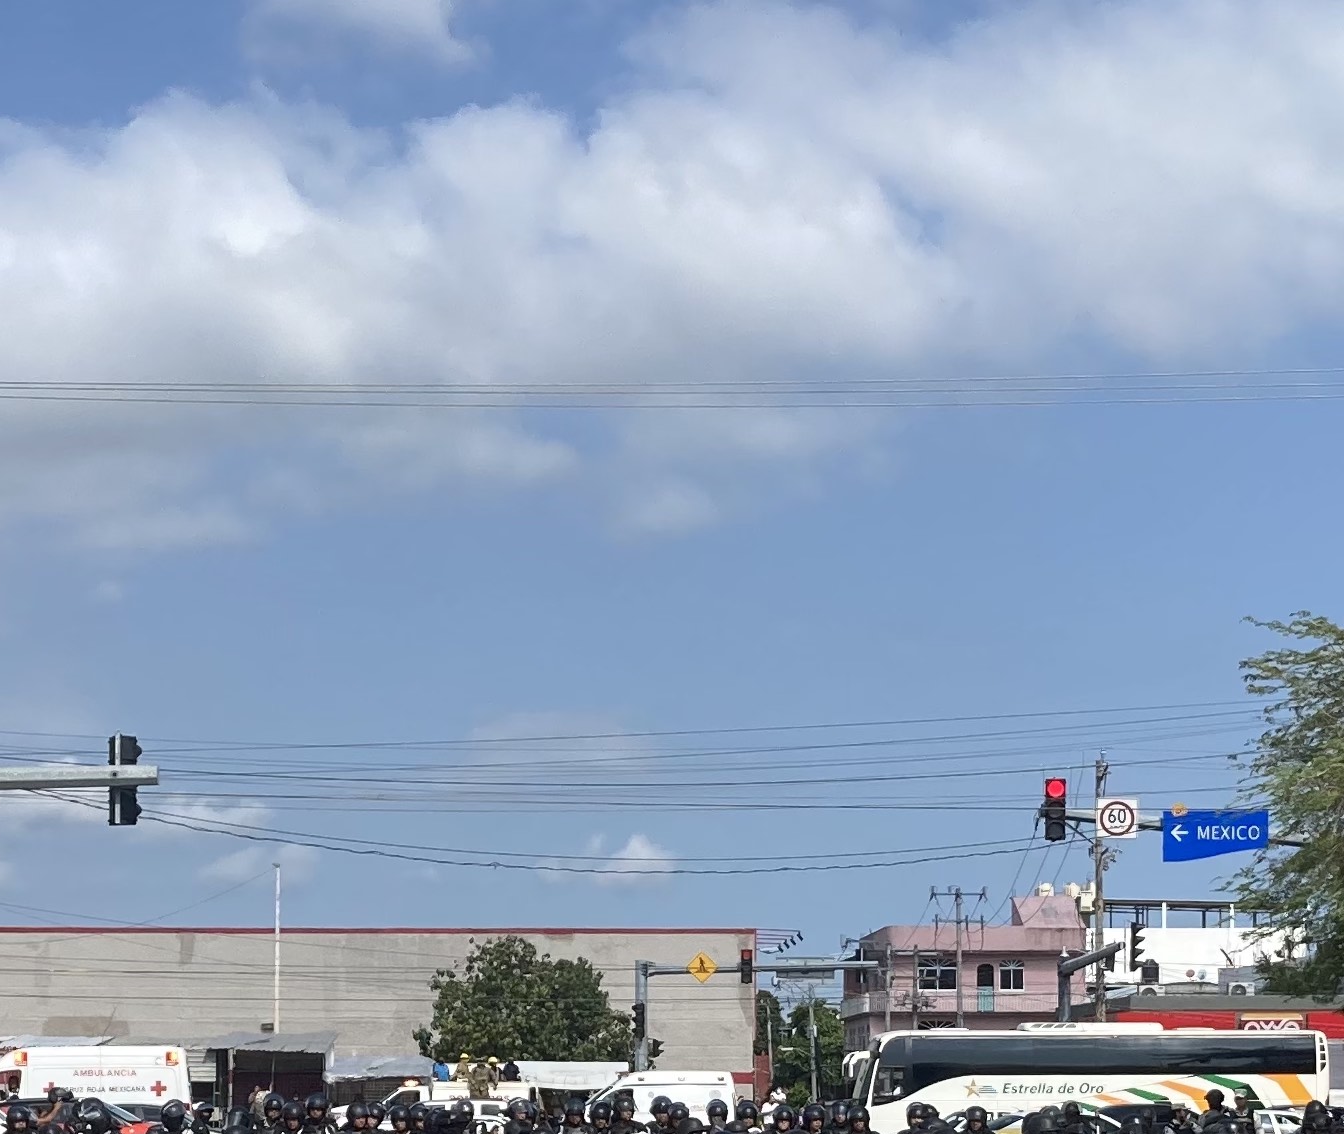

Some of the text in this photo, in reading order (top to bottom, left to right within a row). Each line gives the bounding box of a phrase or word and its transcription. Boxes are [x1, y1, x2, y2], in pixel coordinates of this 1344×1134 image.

[1108, 809, 1126, 823] 60
[1197, 825, 1260, 840] MEXICO
[73, 1069, 137, 1077] AMBULANCIA
[1002, 1083, 1104, 1094] Estrella de Oro
